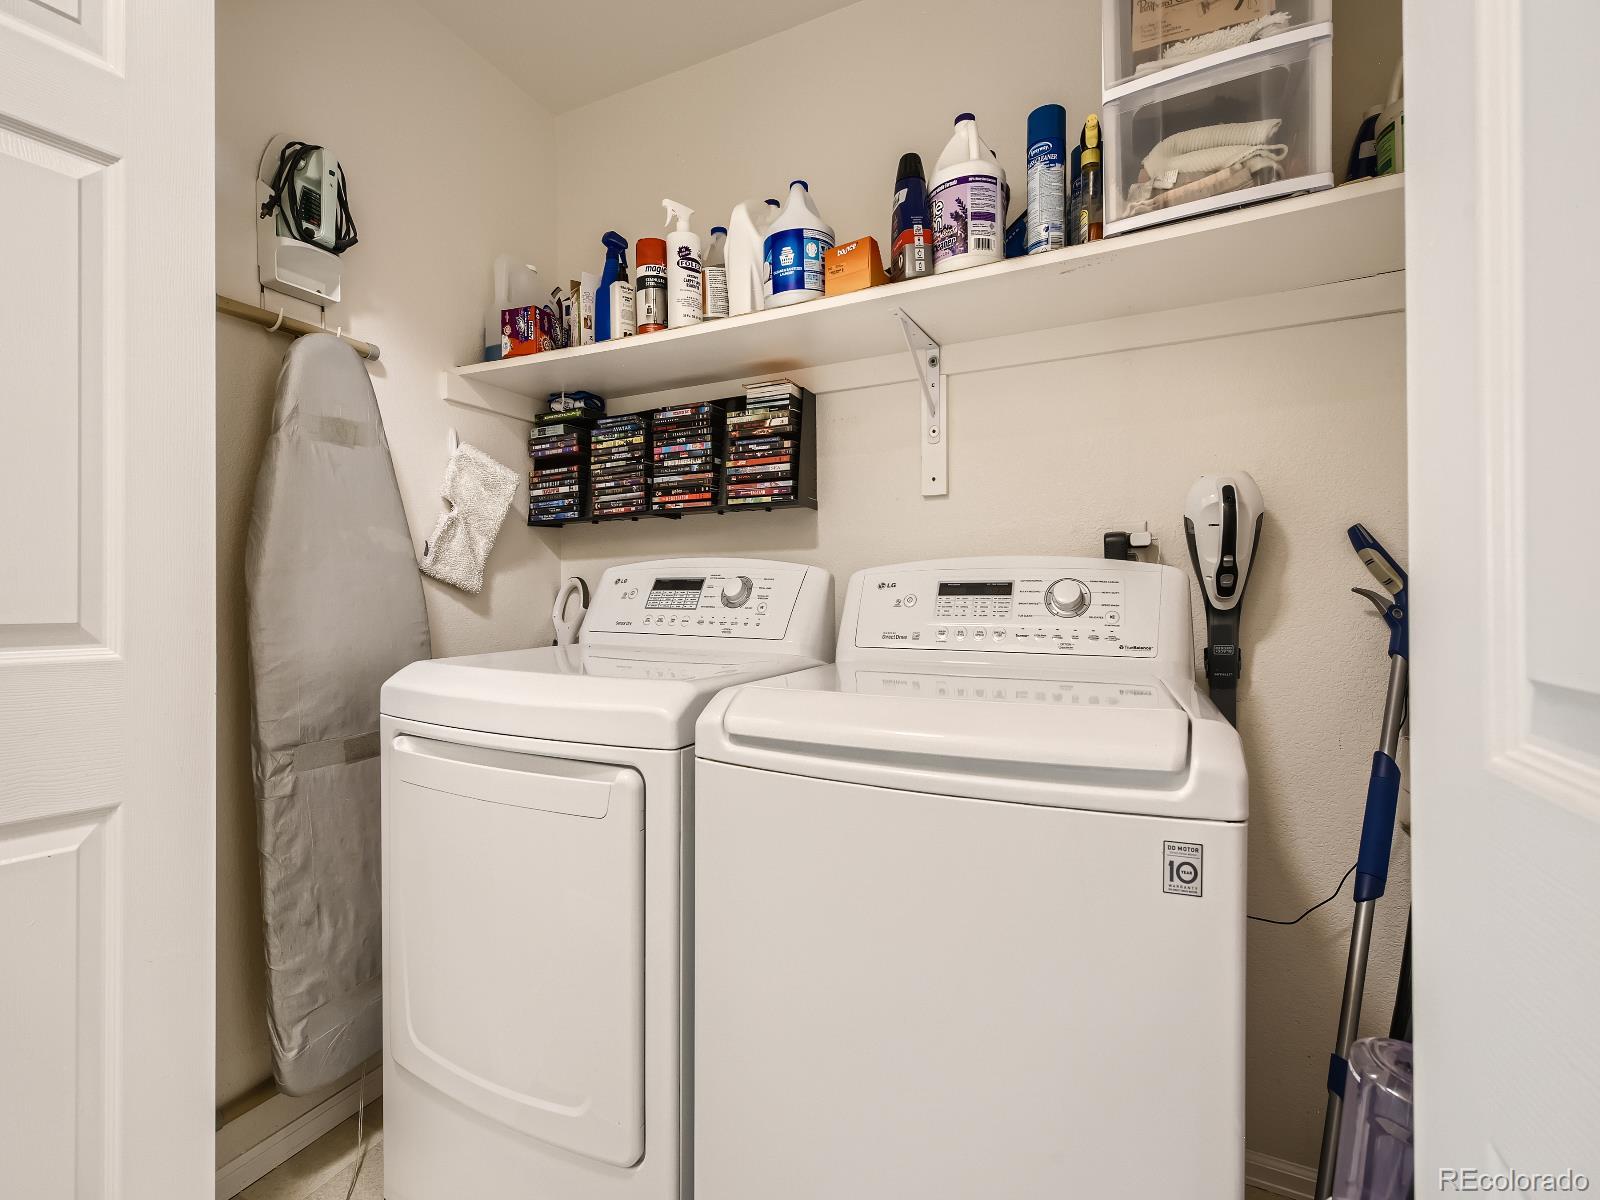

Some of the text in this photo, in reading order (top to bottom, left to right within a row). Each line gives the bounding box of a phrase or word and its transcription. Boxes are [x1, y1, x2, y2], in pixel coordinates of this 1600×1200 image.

[837, 242, 857, 257] bounce
[645, 263, 667, 275] magic
[1168, 860, 1198, 884] 10
